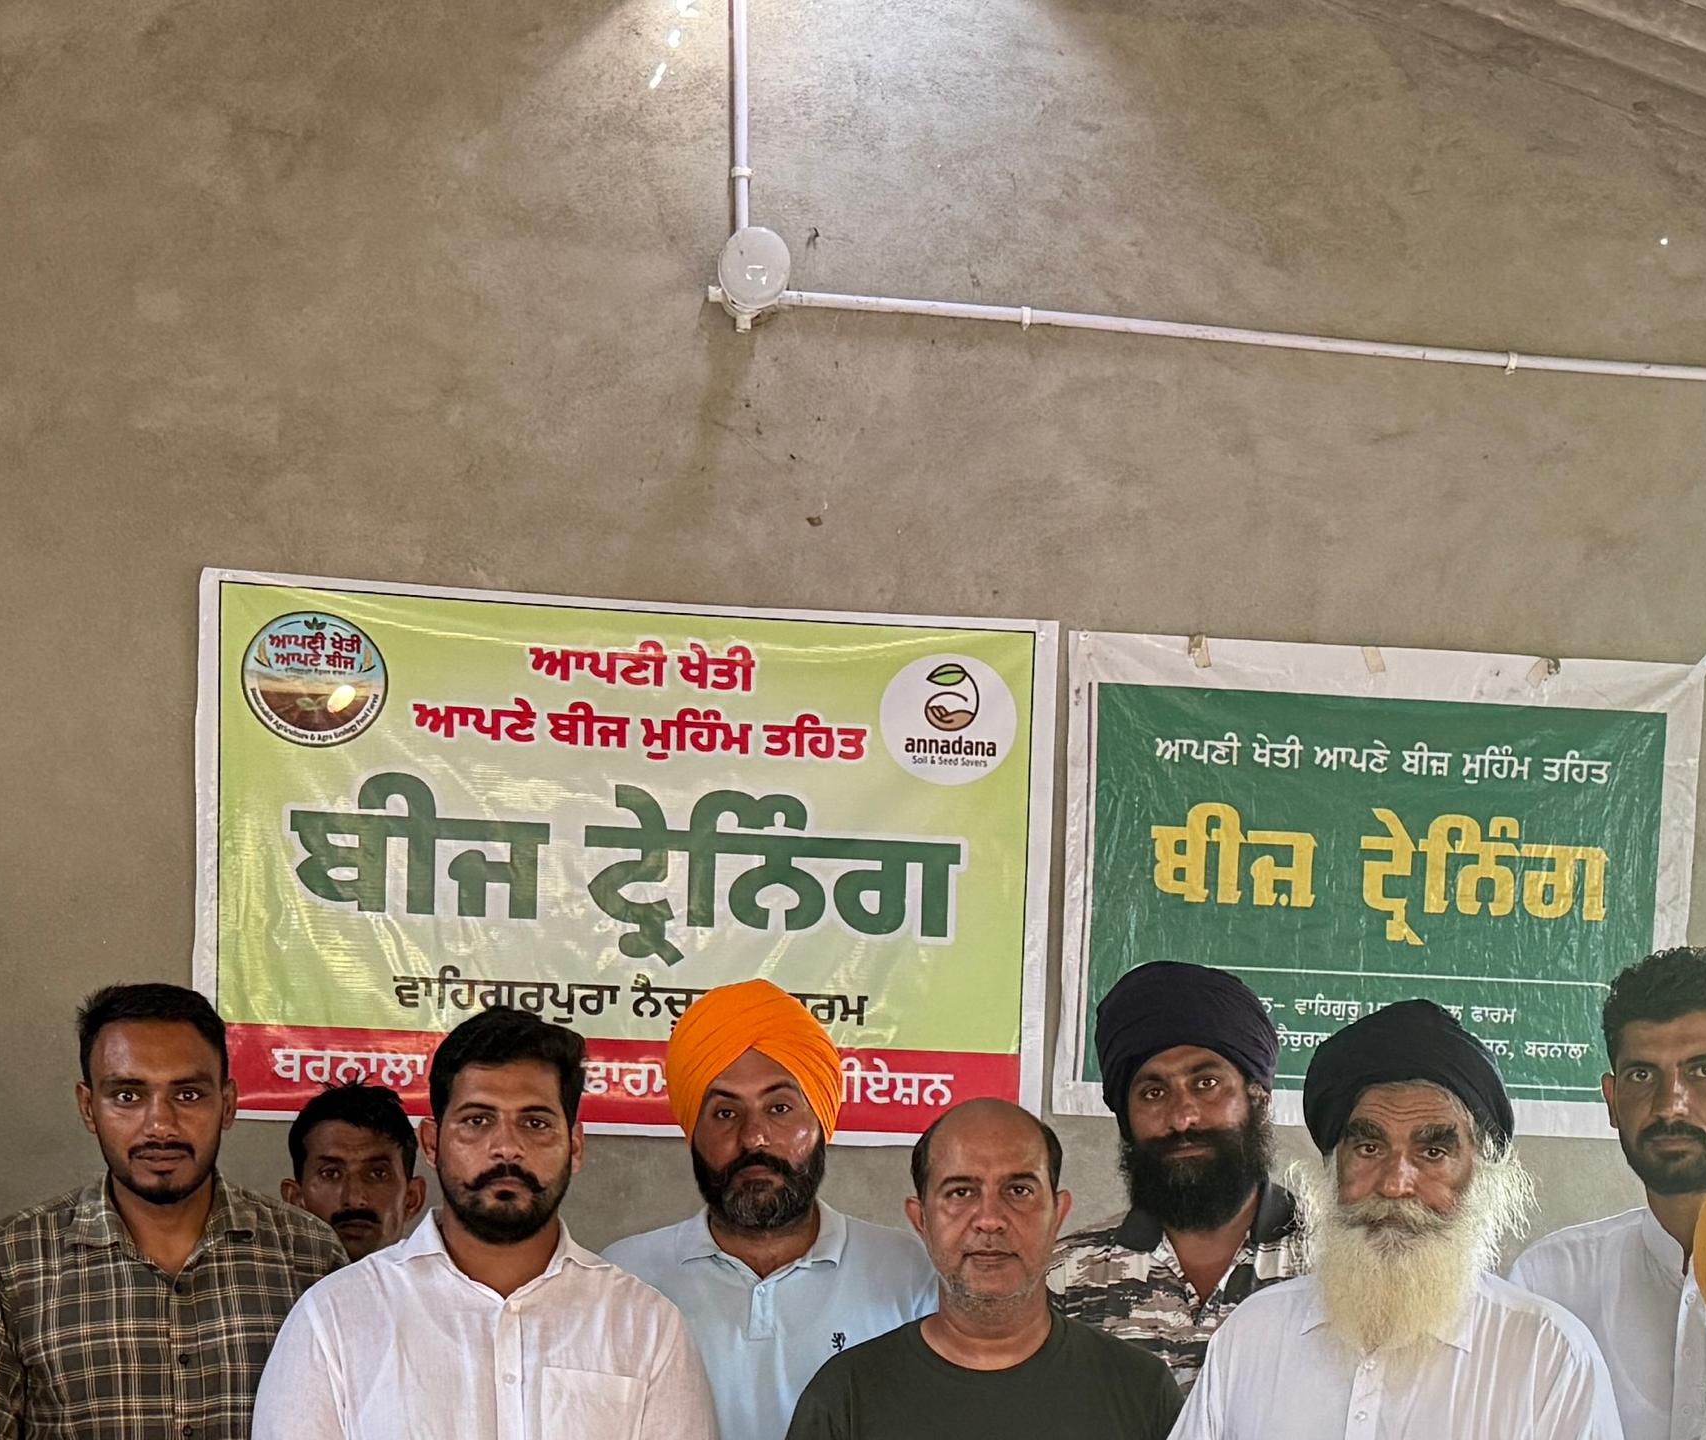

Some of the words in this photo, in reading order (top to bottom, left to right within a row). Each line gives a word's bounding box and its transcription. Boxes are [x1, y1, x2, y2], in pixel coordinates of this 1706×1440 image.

[269, 632, 326, 650] ਆਪਣੀ
[330, 633, 362, 653] ਖੇਤੀ
[274, 651, 321, 666] ਆਪਣੇ
[326, 652, 355, 669] ਬੀਜ
[529, 641, 666, 685] ਆਪਣੀ
[678, 644, 755, 691] ਖੇਤੀ
[413, 697, 536, 741] ਆਪਣੇ
[547, 701, 629, 747] ਬੀਜ
[642, 707, 751, 759] ਮੁਹਿੰਮ
[763, 713, 866, 759] ਤਹਿਤ
[905, 736, 996, 756] annadana
[913, 755, 927, 764] Soil
[938, 756, 958, 765] Seed
[961, 758, 987, 767] Savers
[1156, 731, 1241, 766] ਆਪਣੀ
[1253, 733, 1303, 769] ਖੇਤੀ
[1314, 741, 1389, 772] ਆਪਣੇ
[1462, 745, 1531, 784] ਮੁਹਿੰਮ
[1542, 750, 1611, 785] ਤਹਿਤ
[291, 773, 550, 919] ਬੀਜ
[585, 784, 960, 966] ਟ੍ਰੇਨਿੰਗ
[1151, 802, 1317, 908] ਬੀਜ਼
[1361, 808, 1608, 945] ਟ੍ਰੇਨਿੰਗ
[1471, 1006, 1516, 1024] ਫਾਰਮ
[272, 1049, 426, 1087] ਬਰਨਾਲਾ
